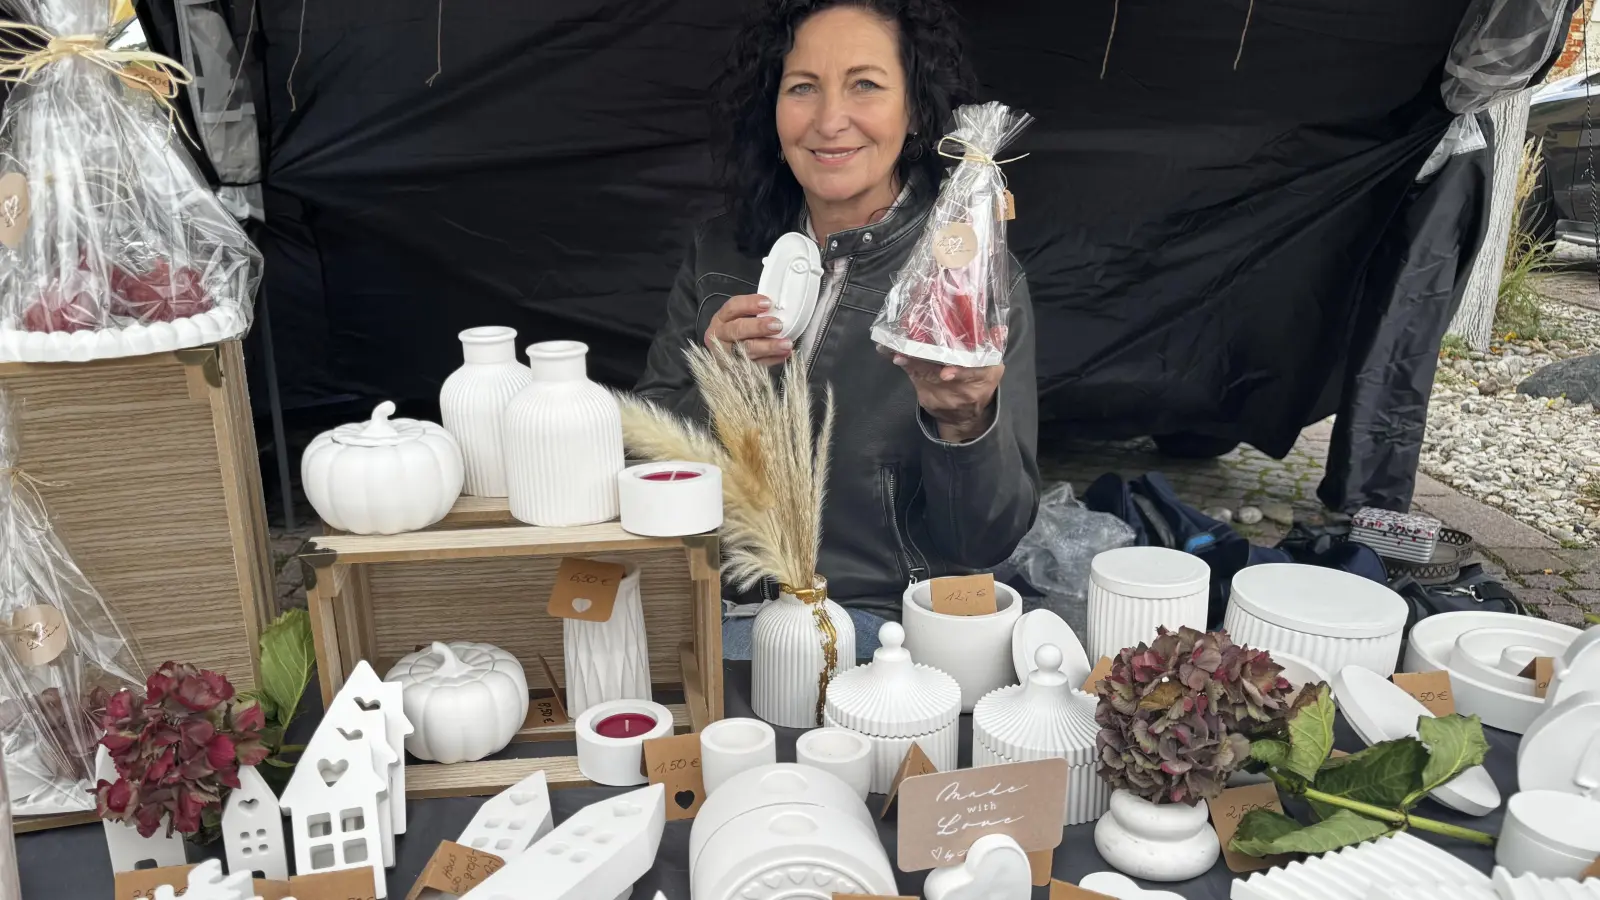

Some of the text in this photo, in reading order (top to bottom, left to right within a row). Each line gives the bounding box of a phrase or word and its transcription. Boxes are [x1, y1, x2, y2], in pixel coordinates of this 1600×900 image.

[1437, 690, 1448, 701] €
[654, 757, 701, 774] 1,50 €
[936, 781, 1029, 803] Made
[966, 801, 997, 814] with
[936, 813, 1025, 836] Love
